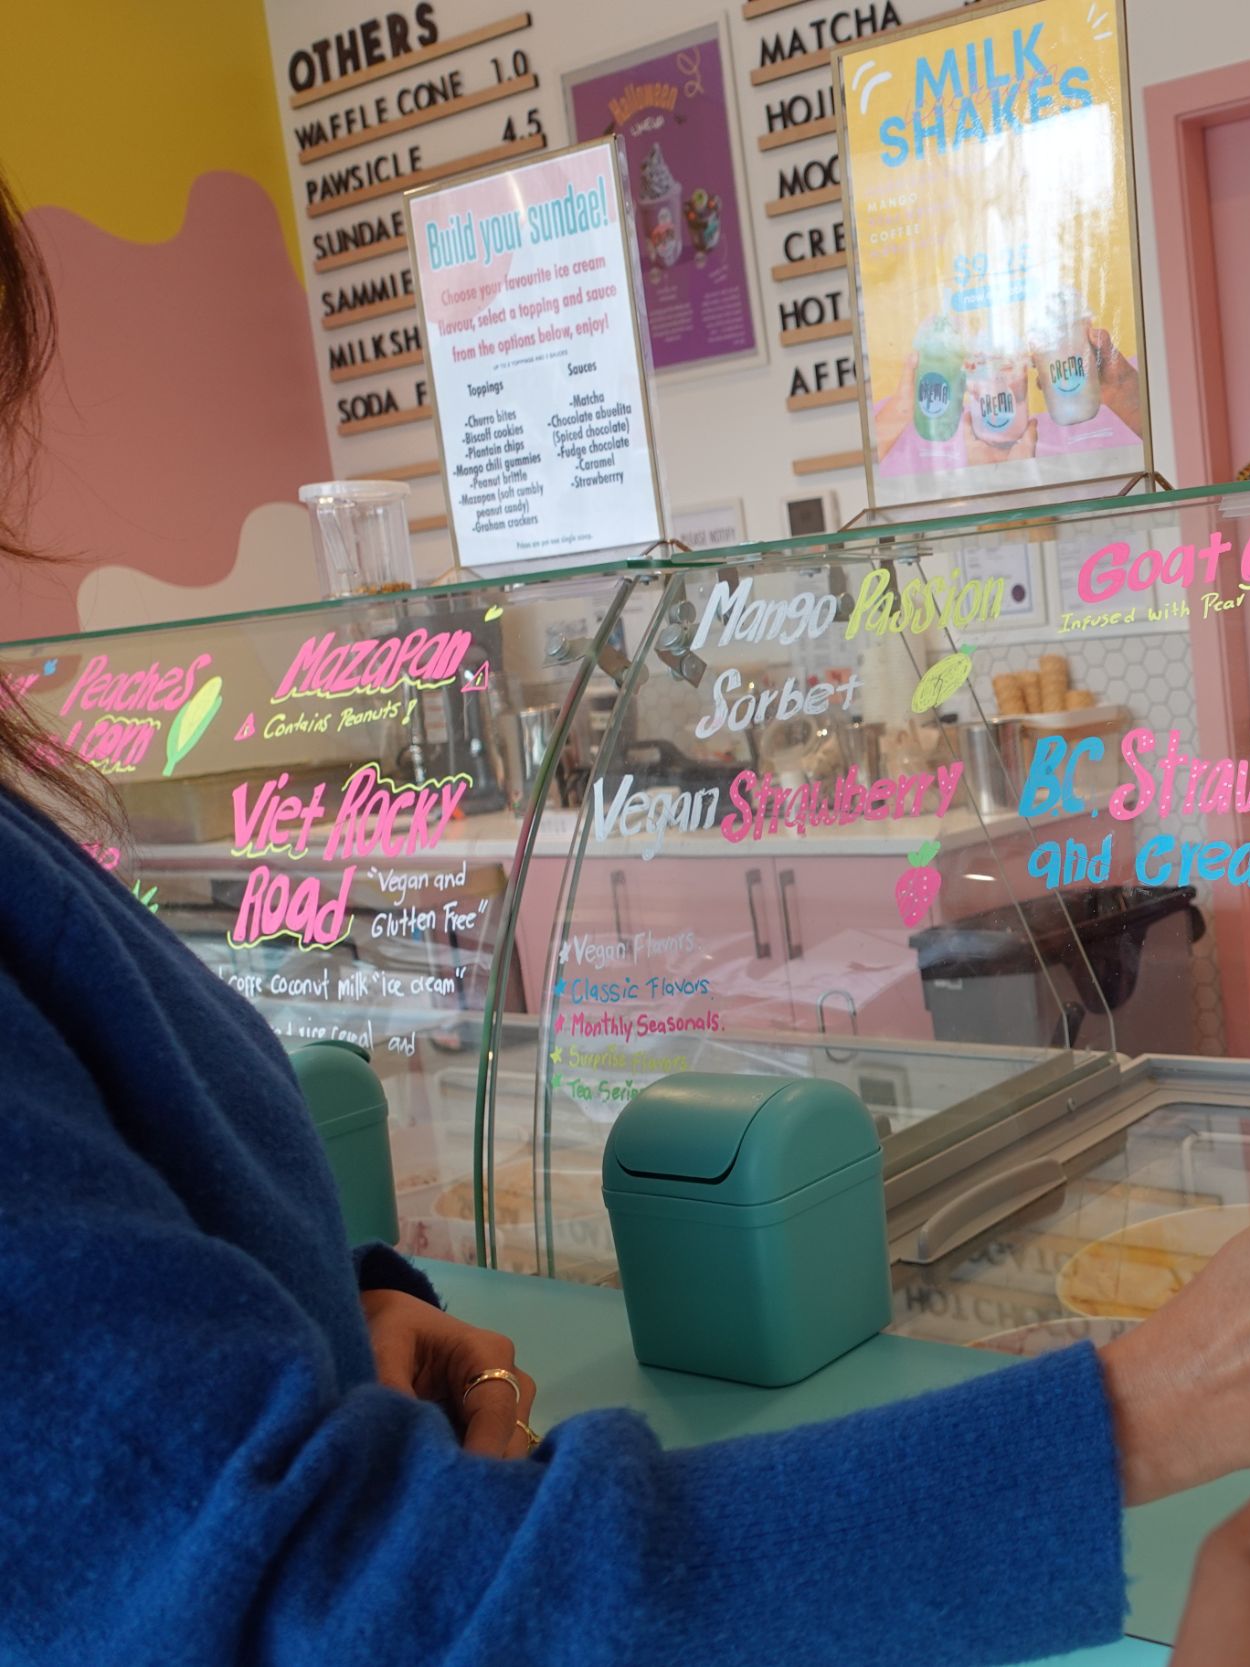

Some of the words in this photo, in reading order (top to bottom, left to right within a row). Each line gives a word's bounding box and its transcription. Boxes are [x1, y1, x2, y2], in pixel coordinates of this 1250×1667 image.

[288, 1, 439, 94] OTHERS
[761, 0, 902, 68] MATCHA
[914, 22, 1046, 111] MILK
[295, 97, 389, 151] WAFFLE
[396, 71, 464, 118] CONE
[491, 49, 530, 85] 1.0
[878, 65, 1094, 169] SHAKES
[501, 108, 544, 144] 4.5
[306, 146, 424, 205] PAWSICLE
[313, 211, 405, 261] SUNDAE
[426, 211, 478, 271] Build
[479, 211, 523, 266] your
[527, 175, 609, 245] sundae!
[784, 222, 846, 264] CRE
[321, 269, 414, 317] SAMMIE
[440, 285, 478, 307] Choose
[479, 280, 503, 300] your
[503, 267, 551, 292] favourite
[553, 264, 570, 279] ice
[572, 256, 606, 275] cream
[437, 318, 476, 337] flavour,
[477, 307, 506, 328] select
[508, 307, 518, 319] a
[518, 297, 560, 320] topping
[562, 287, 583, 308] and
[586, 283, 617, 302] sauce
[779, 291, 843, 332] HOT
[328, 326, 422, 371] MILKSH
[451, 345, 477, 363] from
[478, 338, 496, 357] the
[497, 330, 536, 356] options
[538, 319, 574, 345] below,
[575, 312, 609, 337] enjoy!
[567, 361, 598, 377] Sauces
[790, 355, 858, 398] AFF
[1049, 355, 1086, 384] CREMA
[337, 388, 401, 425] SODA
[466, 380, 505, 399] Toppings
[569, 391, 605, 408] -Matcha
[979, 391, 1015, 418] CREMA
[464, 415, 495, 429] -Churro
[495, 409, 517, 426] bites
[547, 412, 593, 428] -Chocolate
[594, 403, 632, 420] abuelita
[552, 430, 584, 447] (Spiced
[585, 419, 630, 439] chocolate)
[461, 430, 492, 446] -Biscoff
[493, 424, 524, 440] cookies
[464, 445, 502, 461] -Plantain
[503, 439, 525, 457] chips
[556, 446, 587, 460] -Fudge
[588, 436, 630, 453] chocolate
[452, 462, 484, 479] -Mango
[485, 456, 503, 472] chili
[504, 452, 542, 472] gummies
[469, 475, 501, 490] -Peanut
[502, 469, 528, 485] brittle
[575, 453, 615, 472] -Caramel
[458, 491, 497, 506] -Mazapan
[497, 487, 515, 502] (soft
[476, 505, 503, 521] peanut
[504, 499, 530, 519] candy)
[471, 519, 506, 534] -Graham
[507, 514, 539, 529] crackers
[1077, 531, 1233, 605] Goat
[690, 577, 837, 652] Mango
[844, 567, 1006, 641] Passion
[1057, 606, 1136, 635] Infused
[1147, 599, 1191, 623] with
[1202, 590, 1247, 619] Pear
[59, 653, 213, 717] Peaches
[694, 667, 866, 740] Sorbet
[262, 712, 333, 740] Contains
[231, 772, 327, 851] Viet
[592, 773, 722, 861] Vegan
[721, 759, 964, 845] Strawberry
[433, 859, 466, 892] and
[1027, 832, 1113, 890] and
[233, 864, 358, 945] Road
[573, 933, 627, 970] Vegan
[270, 967, 330, 1001] coconut
[337, 970, 369, 1001] milk
[570, 976, 639, 1005] Classic
[387, 1031, 416, 1057] and
[571, 1011, 634, 1042] Monthly
[567, 1078, 593, 1100] Tea
